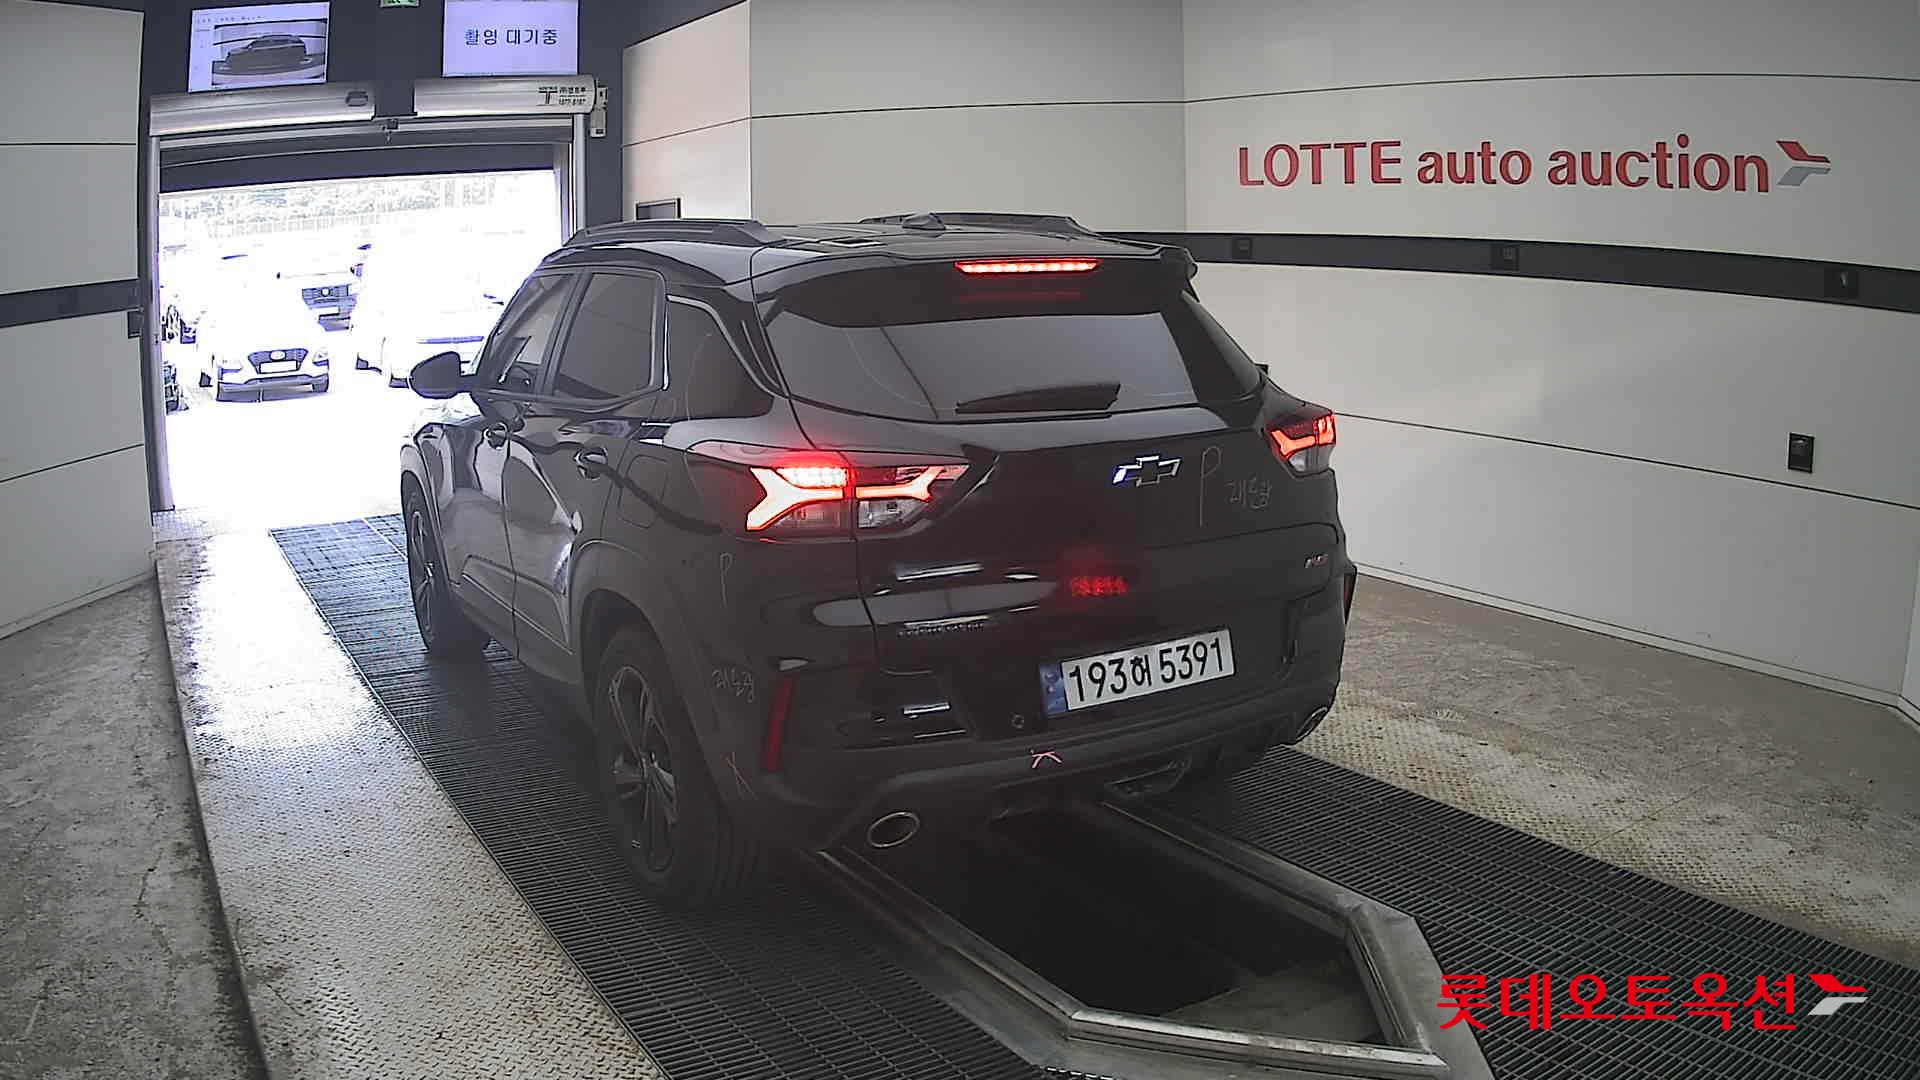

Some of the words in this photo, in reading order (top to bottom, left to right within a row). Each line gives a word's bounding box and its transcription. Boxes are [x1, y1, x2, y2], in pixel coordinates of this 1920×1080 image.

[506, 28, 558, 46] 대기중
[1239, 140, 1402, 187] LOTTE
[1417, 141, 1533, 185] auto
[1548, 133, 1770, 193] auction
[1069, 655, 1153, 702] 193허
[1159, 637, 1223, 684] 5391
